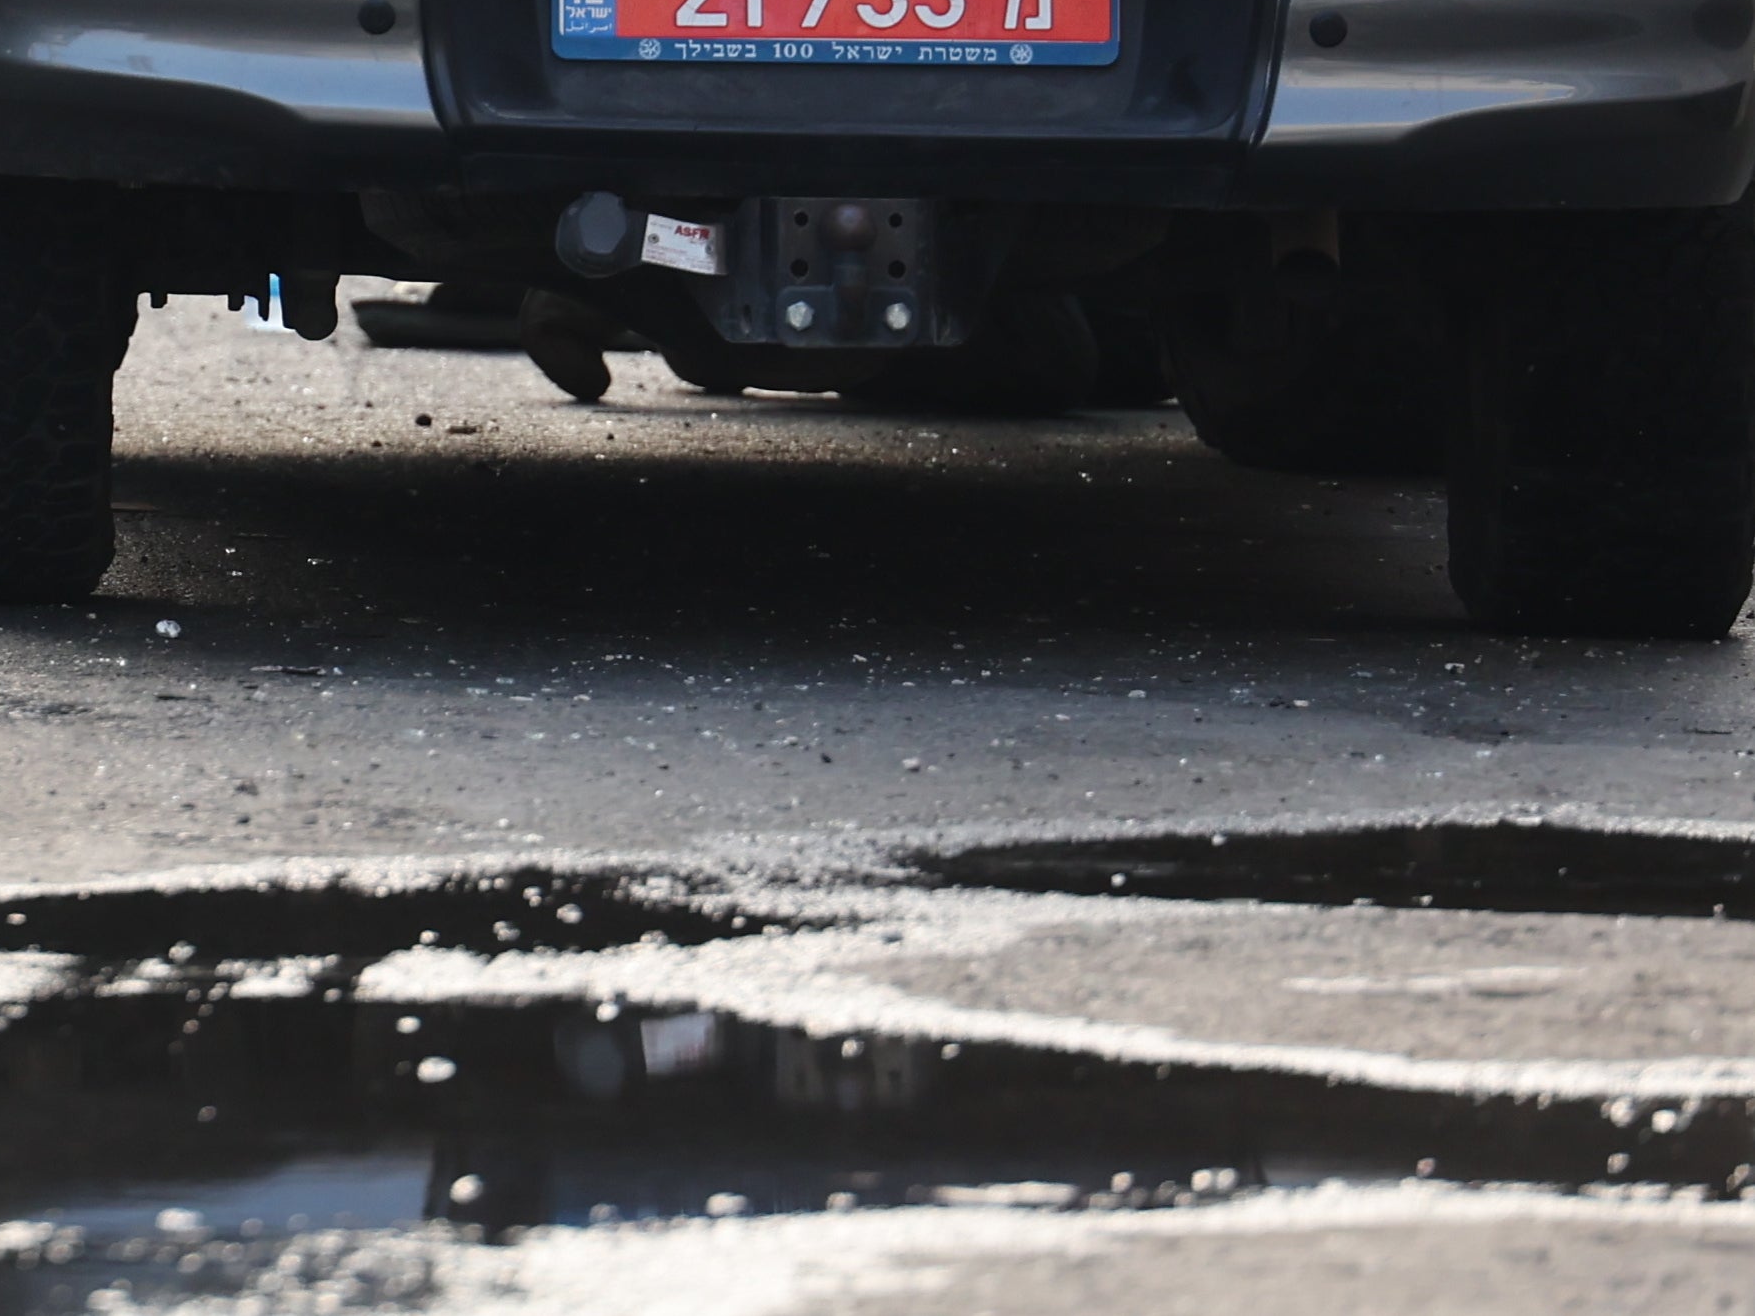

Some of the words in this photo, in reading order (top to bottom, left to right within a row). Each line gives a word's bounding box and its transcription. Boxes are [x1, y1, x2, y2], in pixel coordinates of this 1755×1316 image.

[565, 5, 613, 19] ישראל
[674, 38, 758, 60] בשבילך
[773, 42, 814, 59] 100
[831, 41, 902, 62] ישראל
[917, 45, 998, 62] משטרת
